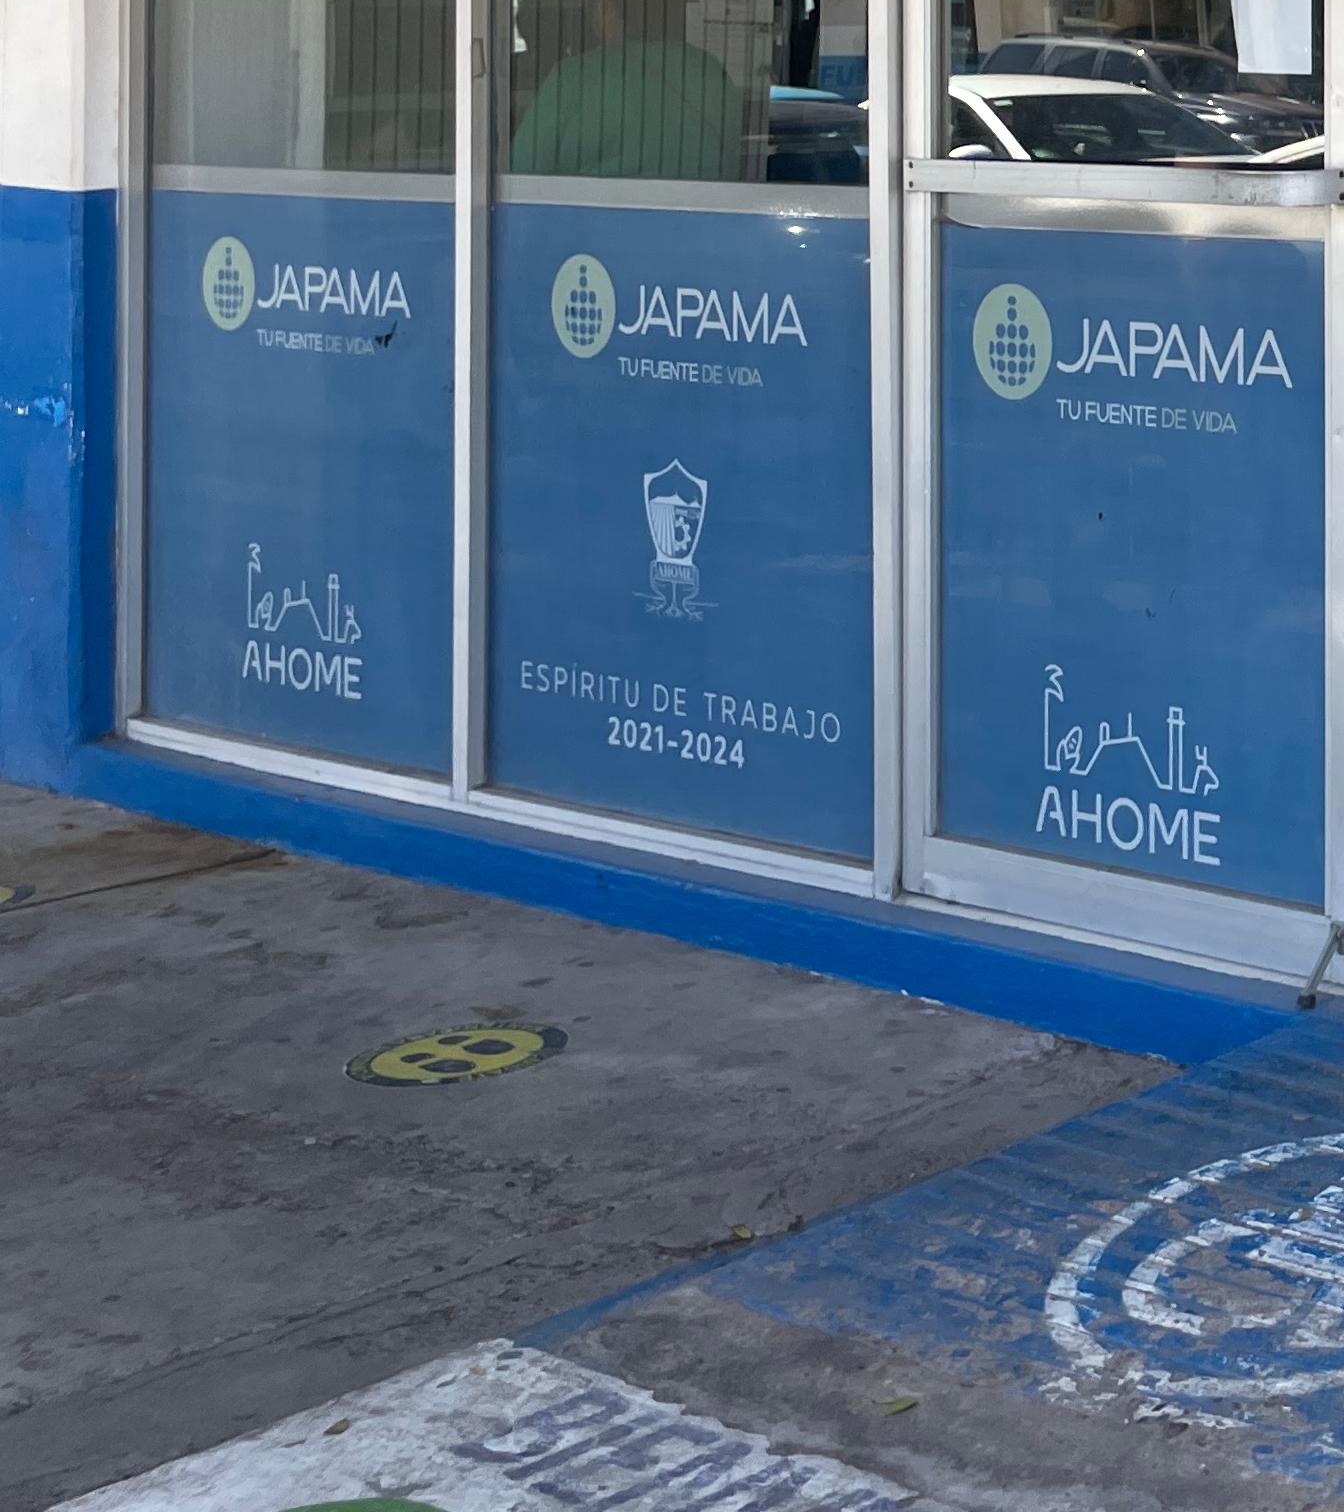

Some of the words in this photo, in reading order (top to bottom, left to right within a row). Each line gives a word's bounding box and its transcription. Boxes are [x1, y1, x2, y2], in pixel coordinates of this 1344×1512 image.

[257, 265, 411, 319] JAPAMA
[618, 284, 808, 347] JAPAMA
[257, 329, 274, 348] TU
[275, 330, 323, 353] FUENTE
[325, 334, 343, 354] DE
[1056, 317, 1292, 389] JAPAMA
[618, 356, 639, 377] TU
[640, 358, 699, 383] FUENTE
[702, 363, 722, 385] DE
[727, 364, 764, 388] VIDA
[1056, 397, 1080, 422] TU
[1085, 401, 1156, 429] FUENTE
[1161, 407, 1187, 430] DE
[1191, 409, 1237, 434] VIDA
[242, 639, 362, 700] AHOME
[521, 660, 640, 710] ESPÍRITU
[654, 684, 688, 717] DE
[703, 691, 841, 745] TRABAJO
[607, 716, 745, 768] 2021-2024
[1036, 785, 1221, 867] AHOME
